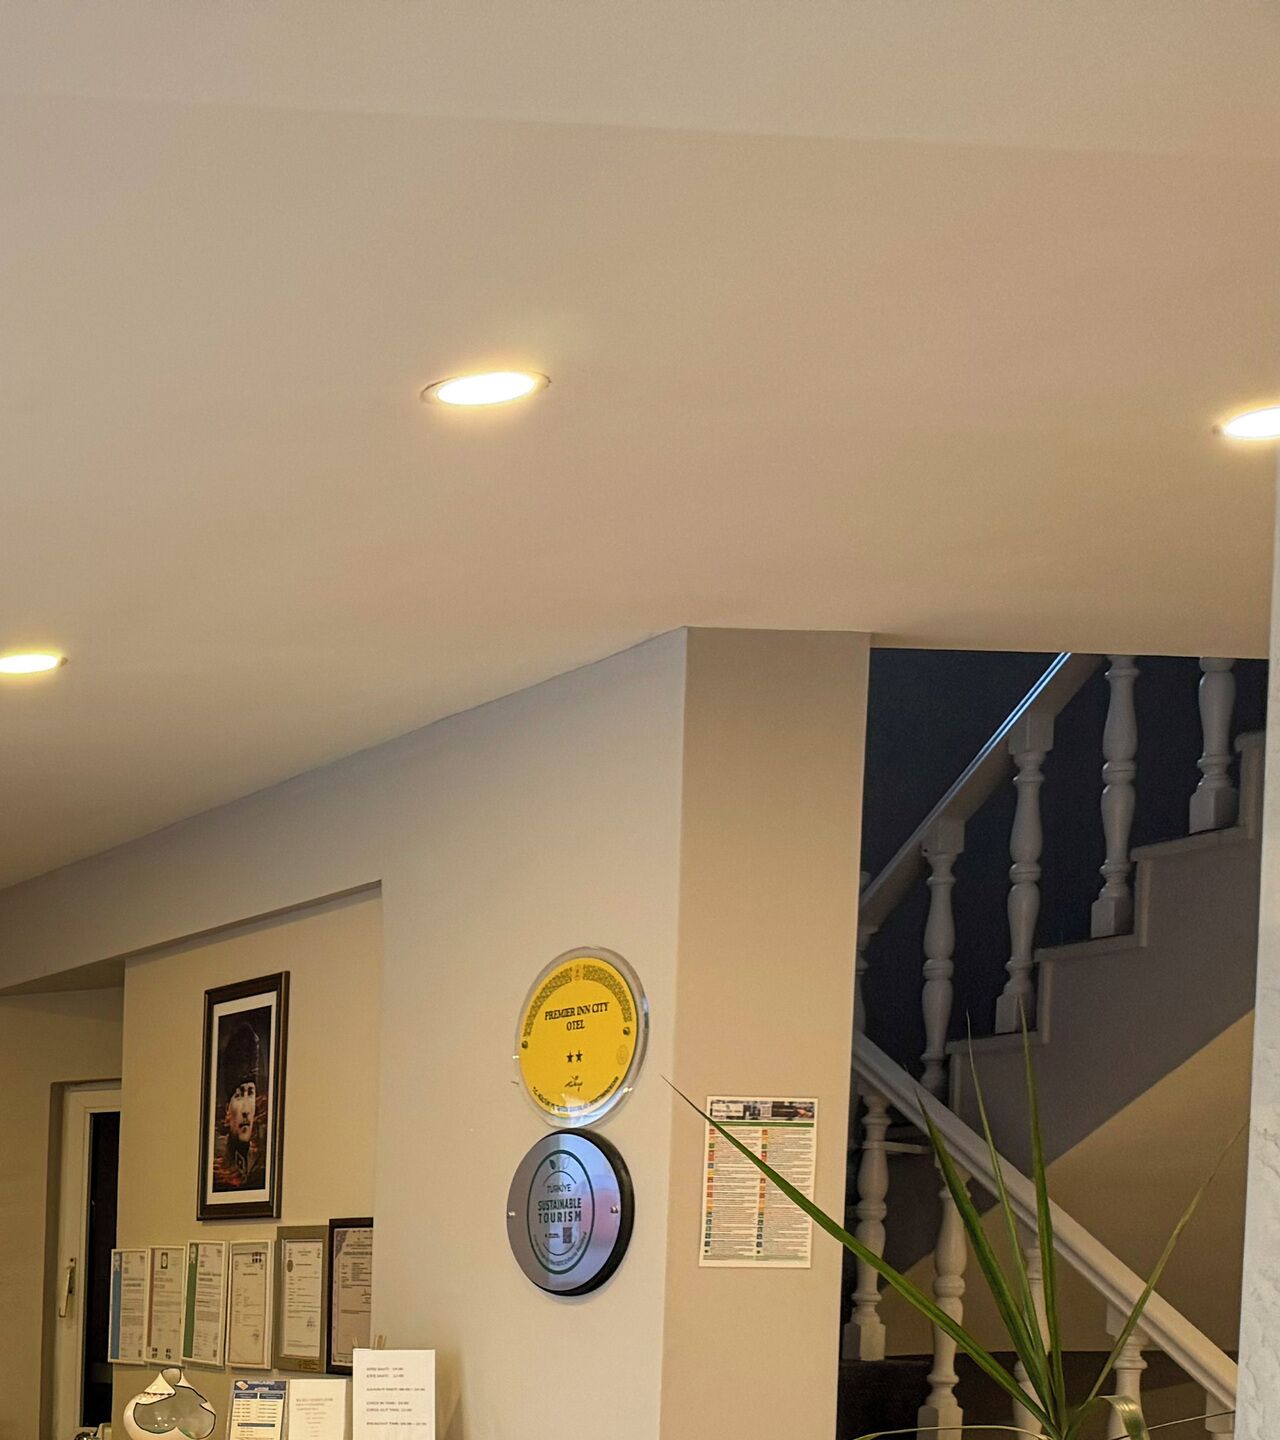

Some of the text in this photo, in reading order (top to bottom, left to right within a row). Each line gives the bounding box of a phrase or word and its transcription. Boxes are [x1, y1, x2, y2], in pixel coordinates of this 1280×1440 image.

[544, 1002, 610, 1021] PREMIER INN CITY
[566, 1020, 585, 1031] OTEL
[537, 1198, 582, 1211] SUSTAINABLE
[538, 1210, 582, 1224] TOURISM
